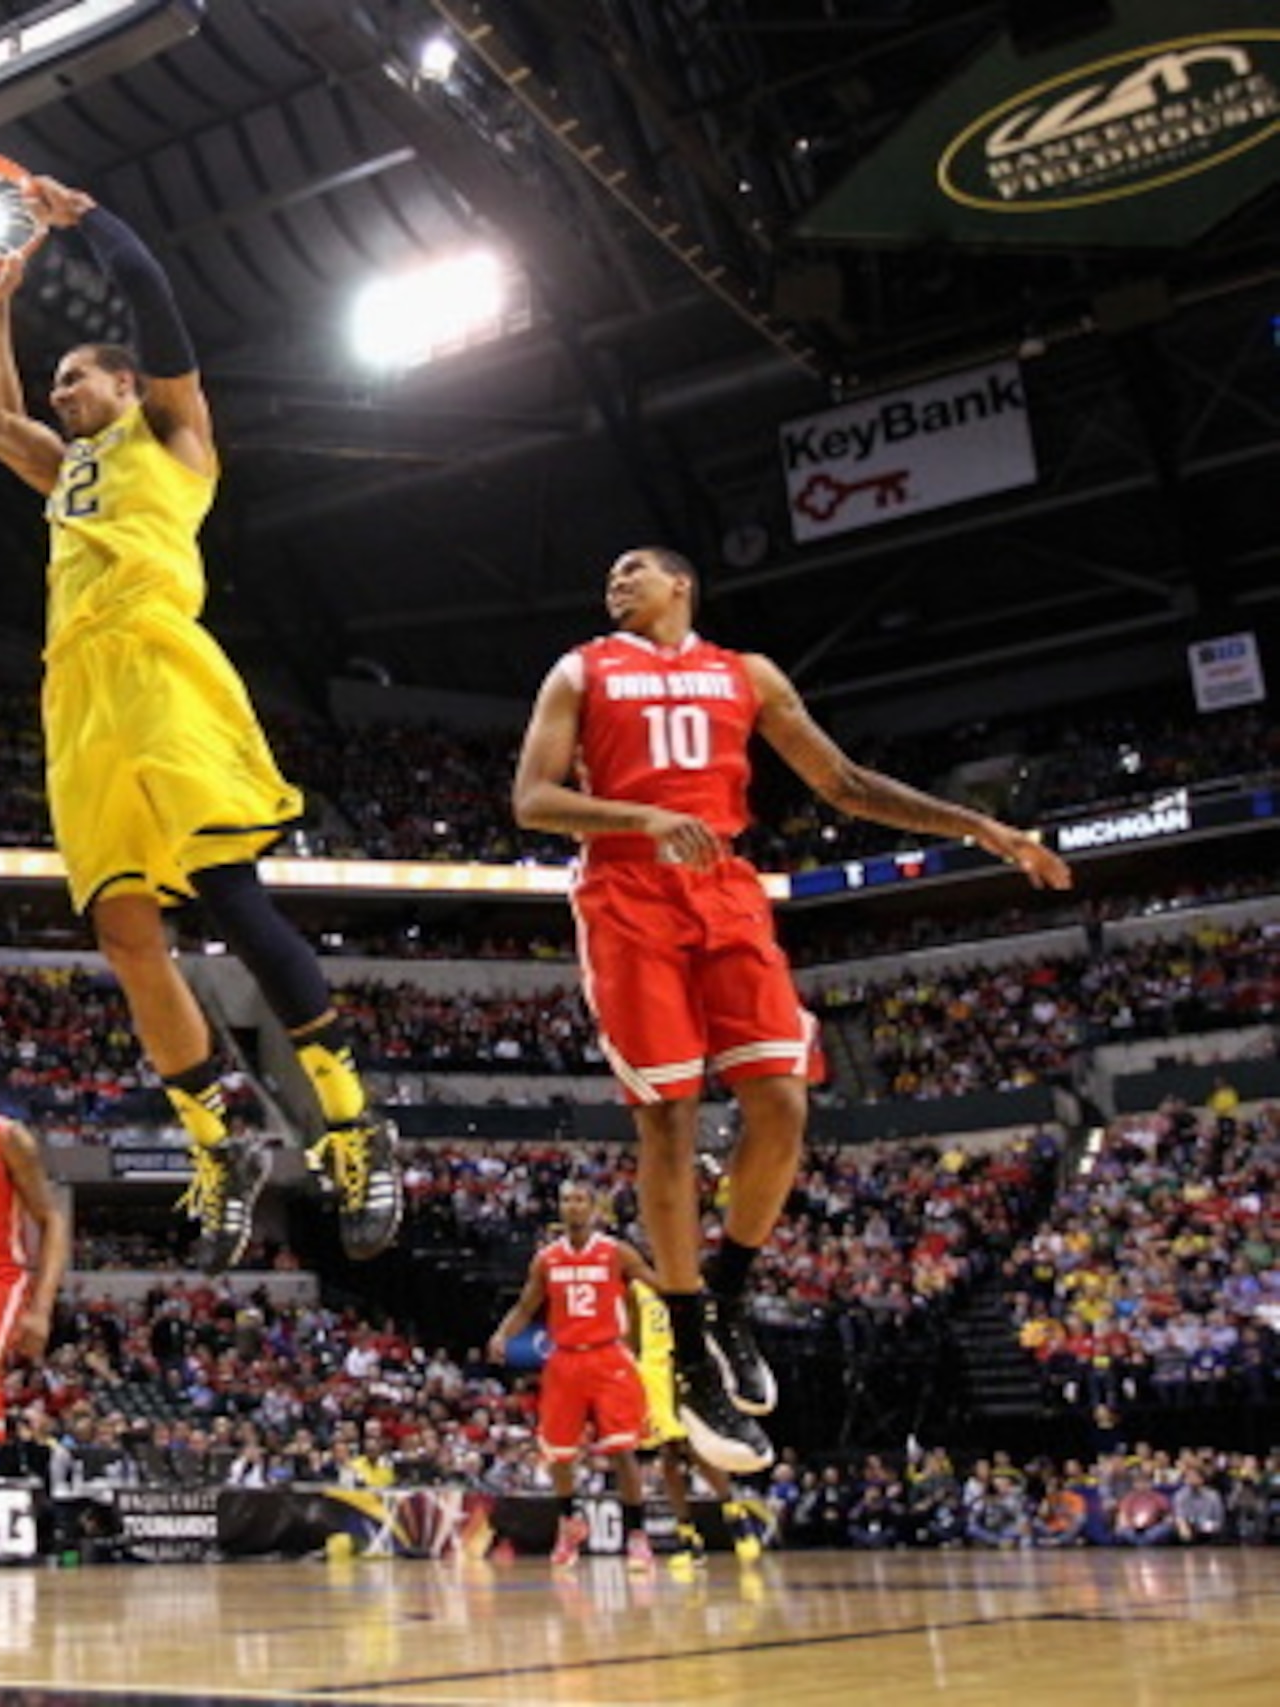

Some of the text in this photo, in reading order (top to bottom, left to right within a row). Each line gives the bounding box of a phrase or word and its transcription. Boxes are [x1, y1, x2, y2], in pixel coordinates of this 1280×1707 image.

[784, 375, 1027, 470] KeyBank
[605, 671, 738, 700] OHIO STATE
[641, 704, 710, 770] 10
[1057, 807, 1190, 852] MICHIGAN
[565, 1283, 597, 1318] 12
